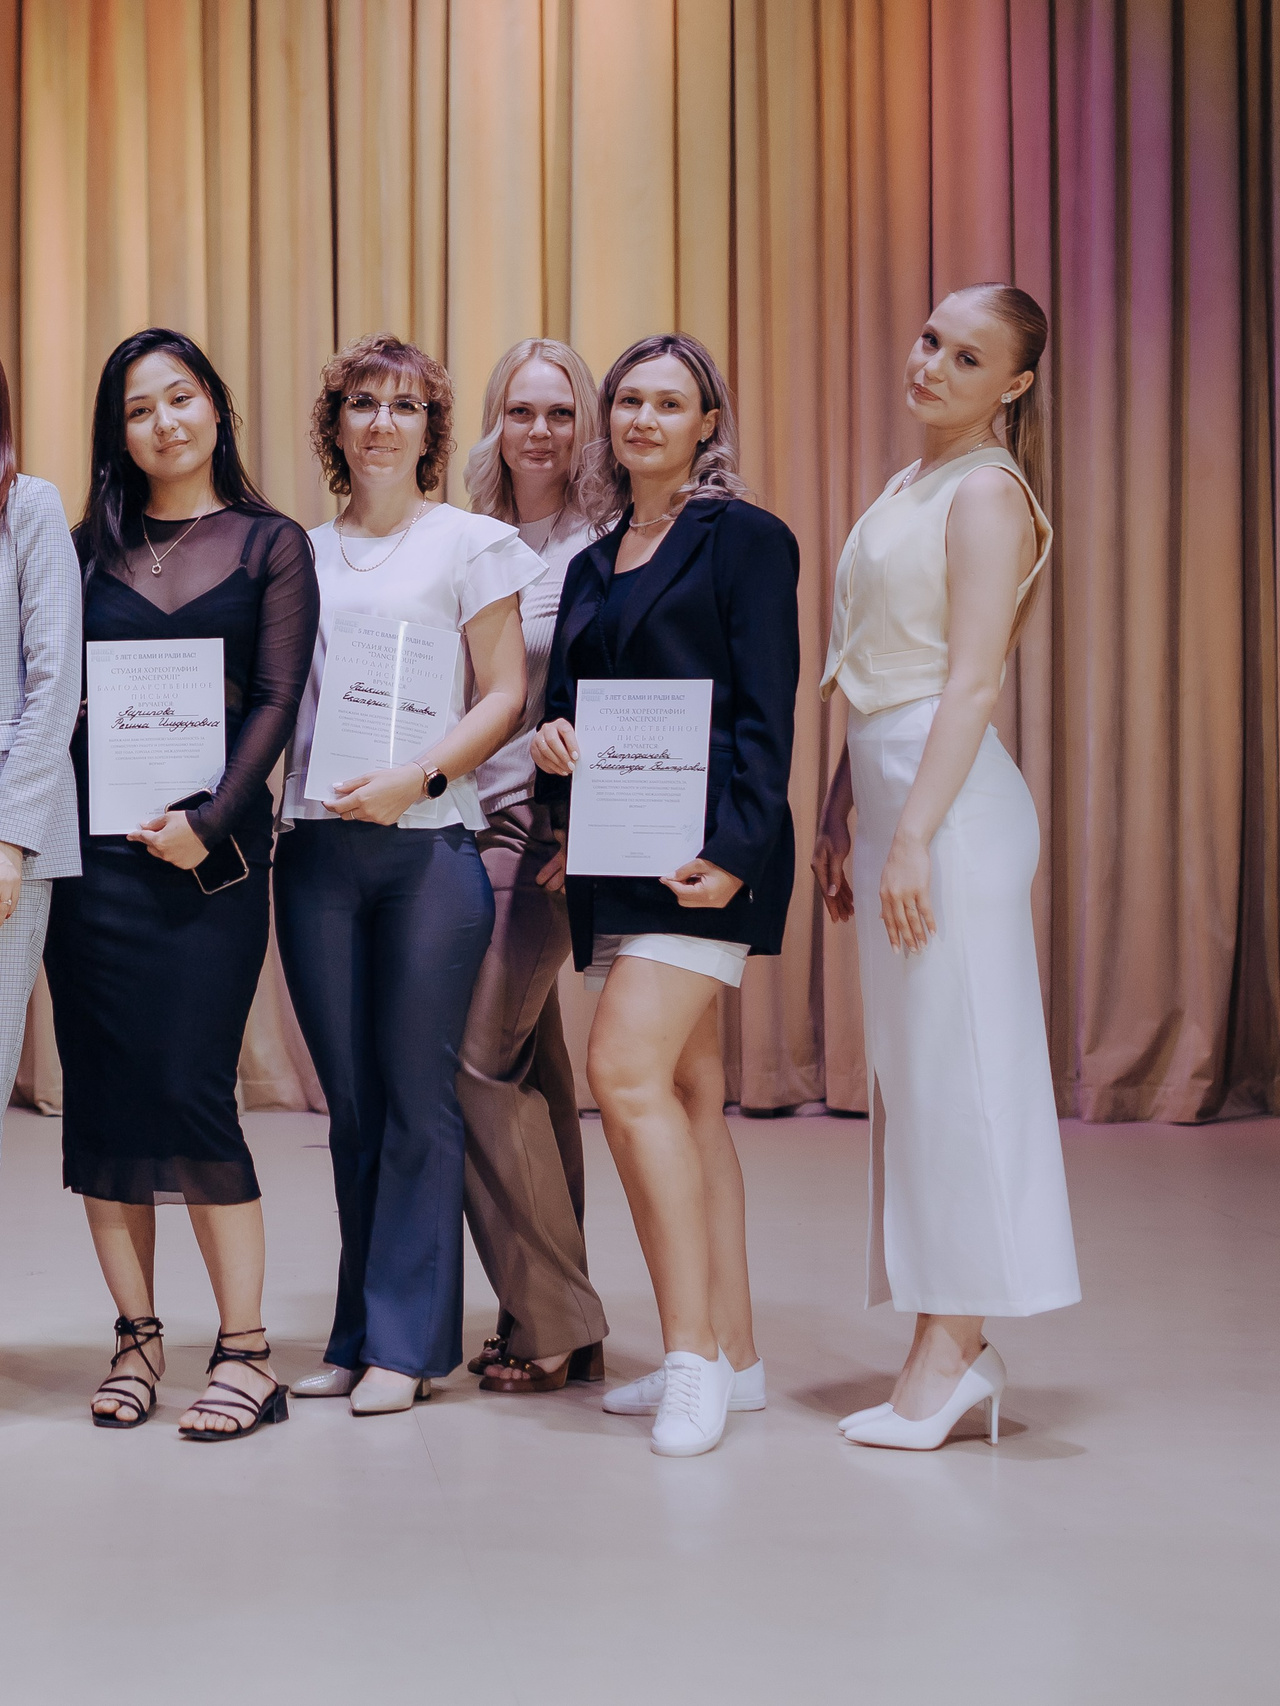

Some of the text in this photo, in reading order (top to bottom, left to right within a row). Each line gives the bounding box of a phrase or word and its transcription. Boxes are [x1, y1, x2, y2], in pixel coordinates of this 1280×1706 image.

[352, 641, 433, 661] СТУДИЯ ХОРОГРАФИИ
[336, 655, 443, 680] БЛАГОДАРСВЕННОЕ
